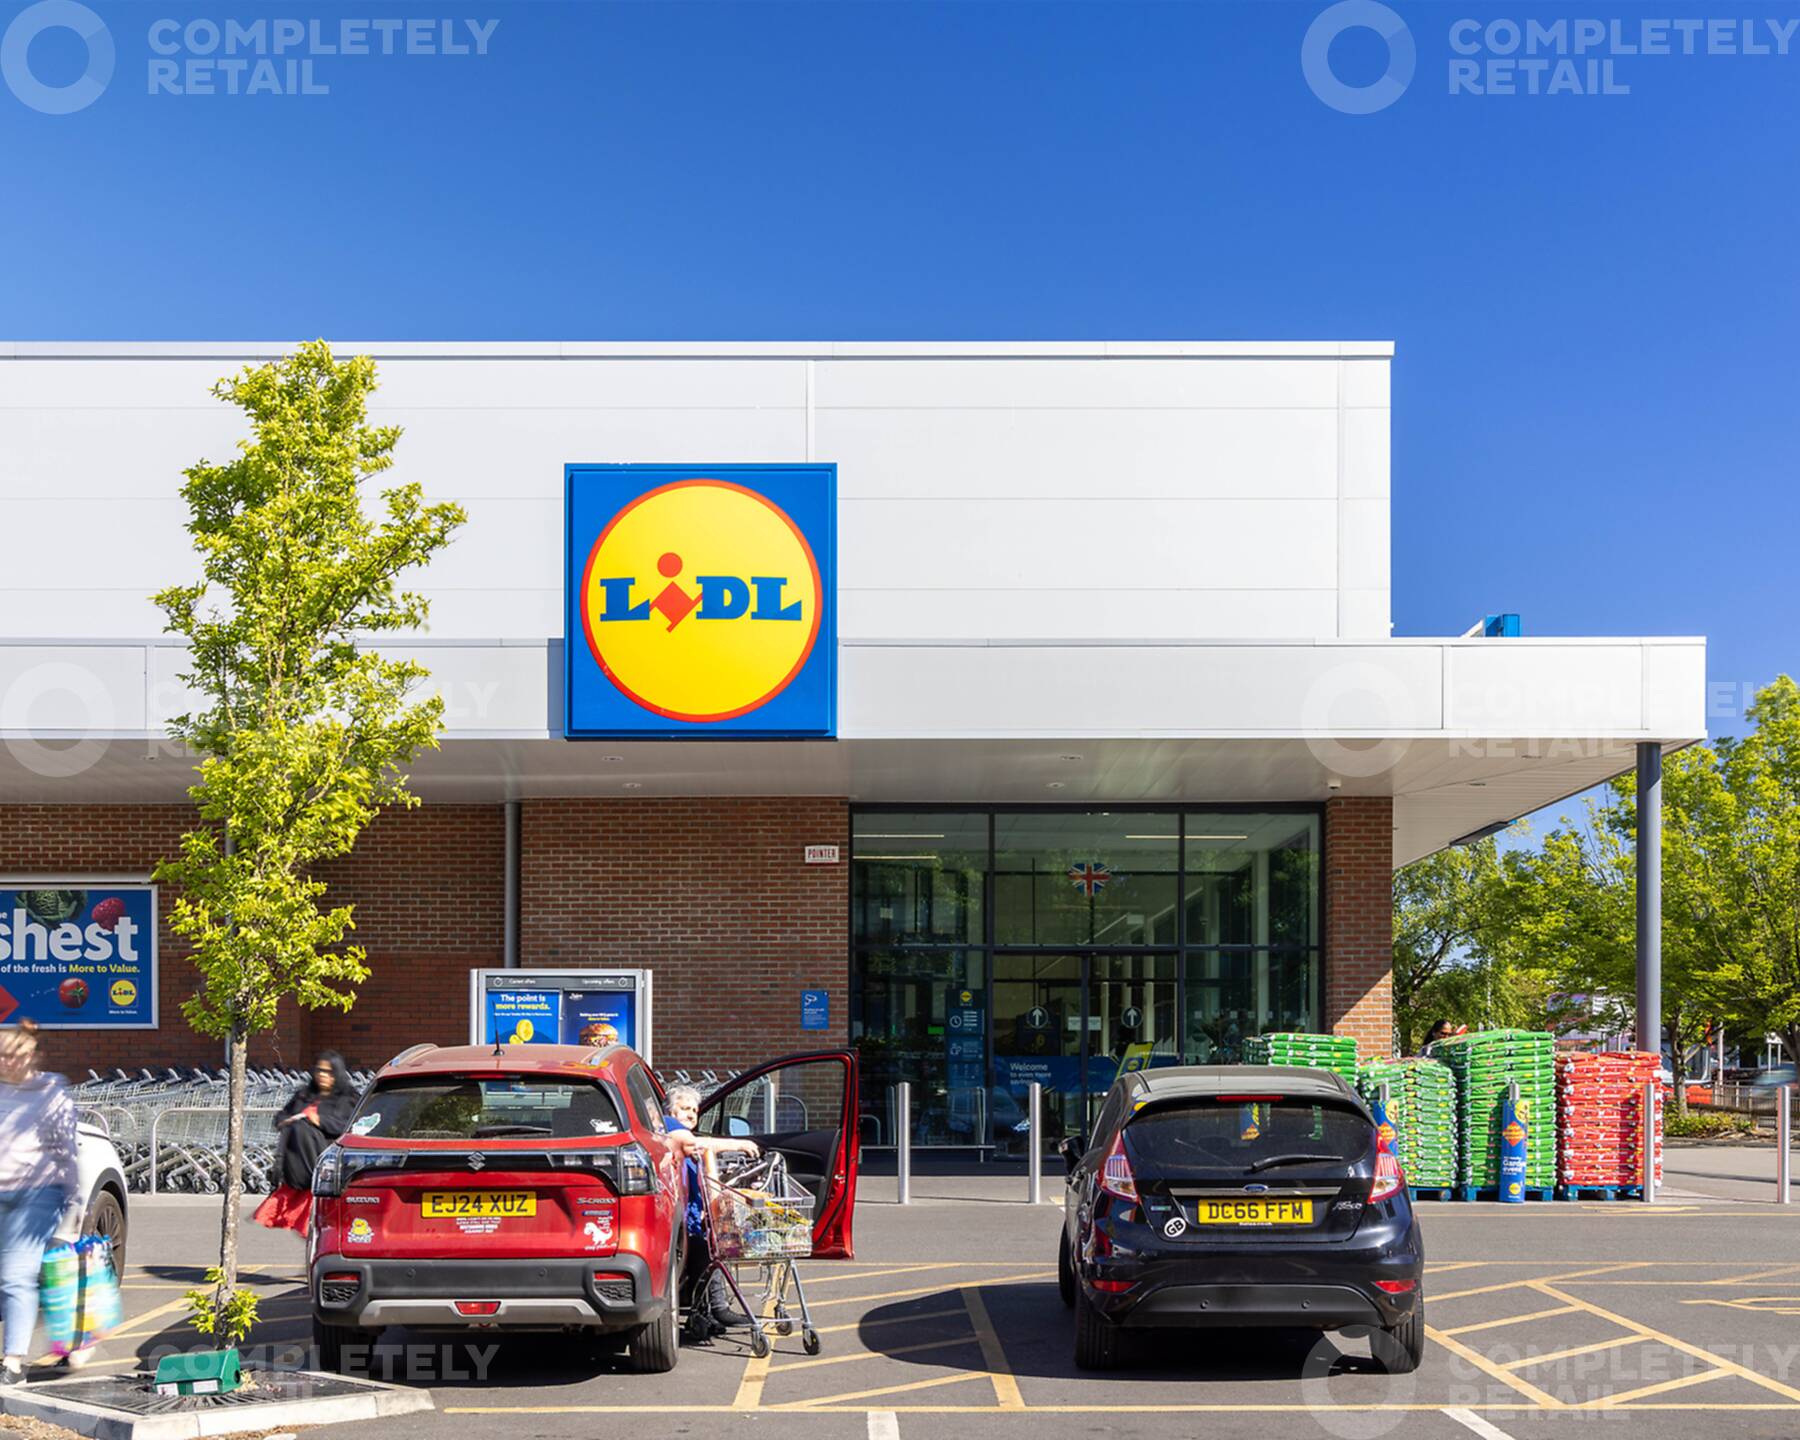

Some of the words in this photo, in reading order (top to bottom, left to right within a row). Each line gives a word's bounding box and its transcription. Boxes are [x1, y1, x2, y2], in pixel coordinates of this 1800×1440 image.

[1, 964, 11, 973] of
[13, 964, 29, 973] the
[32, 964, 56, 973] fresh
[58, 964, 67, 973] is
[69, 964, 95, 973] More
[97, 965, 107, 973] to
[109, 964, 140, 973] Value.
[500, 994, 516, 1003] The
[517, 994, 537, 1004] point
[539, 994, 546, 1002] is
[1010, 1063, 1048, 1071] Welcome
[432, 1195, 483, 1213] EJ24
[490, 1195, 528, 1213] XUZ
[1208, 1202, 1259, 1220] DC66
[1265, 1202, 1304, 1220] FFM
[1166, 1220, 1184, 1235] GB
